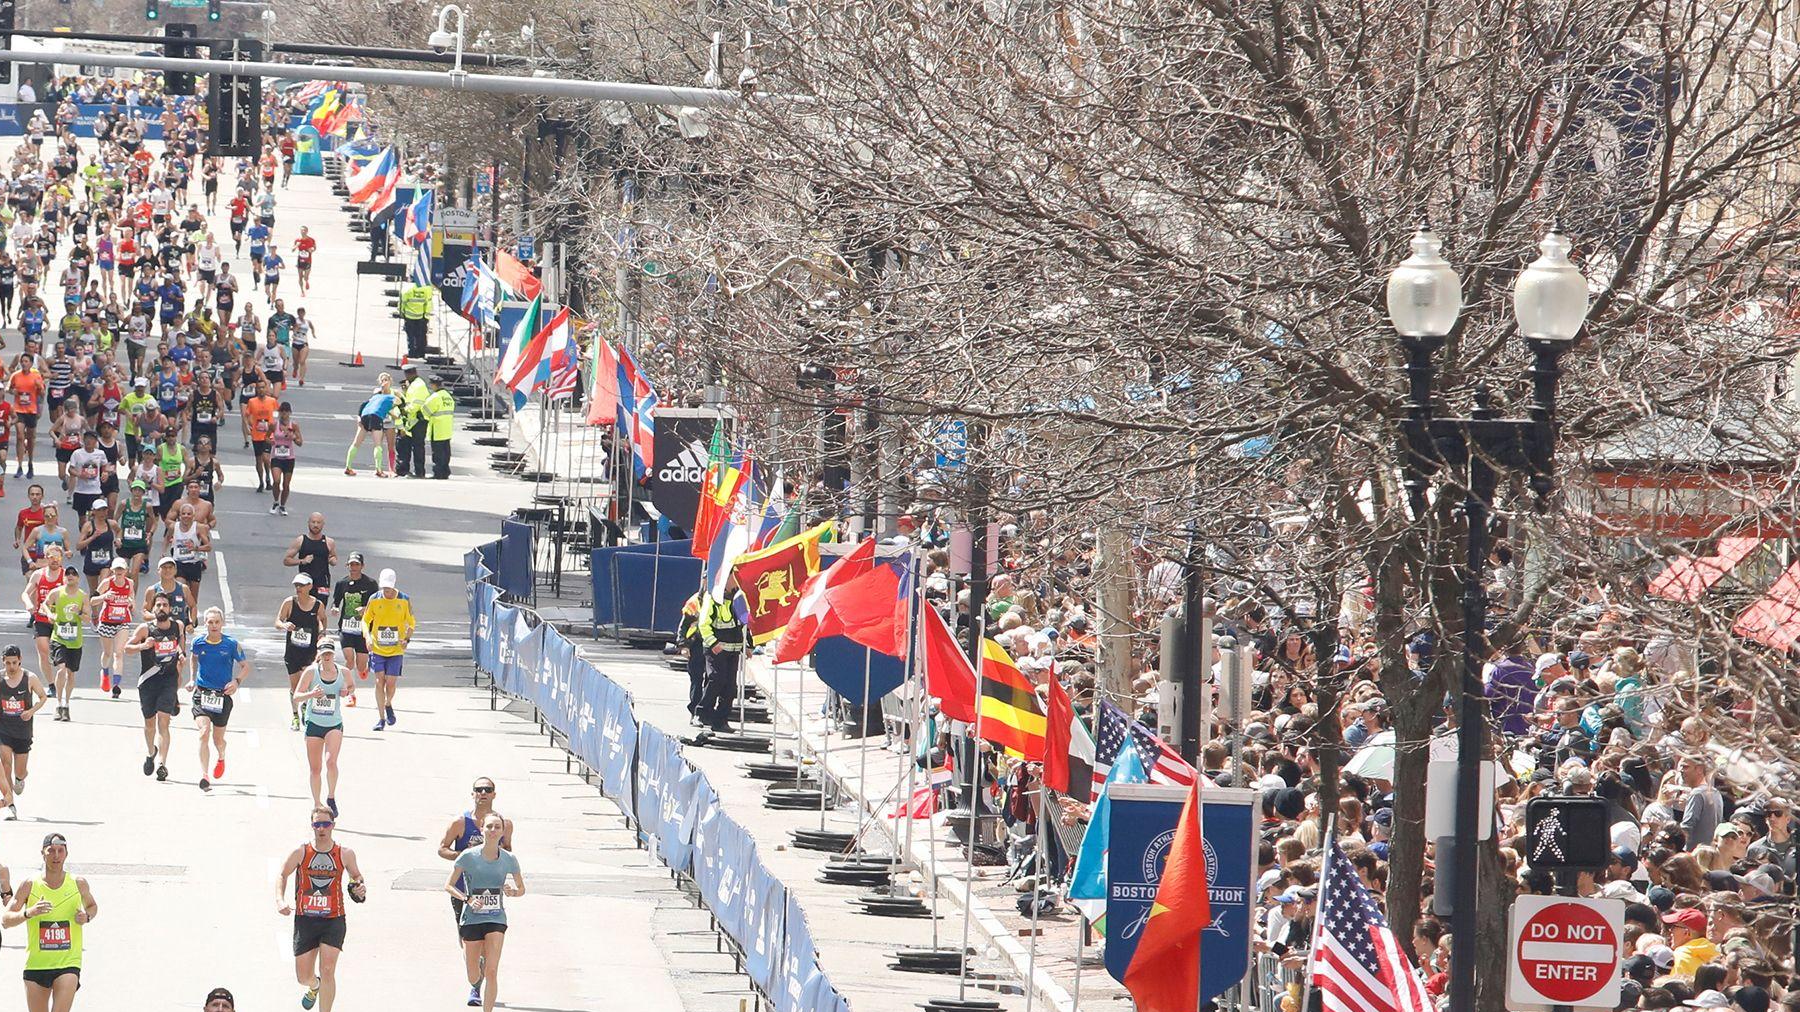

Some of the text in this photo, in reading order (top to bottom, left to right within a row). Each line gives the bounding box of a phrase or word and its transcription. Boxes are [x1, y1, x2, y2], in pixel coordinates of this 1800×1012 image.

[1145, 848, 1157, 880] BOSTON
[308, 897, 328, 908] 7120
[44, 929, 66, 940] 4198
[1530, 923, 1606, 940] DO NOT
[1535, 963, 1598, 981] ENTER
